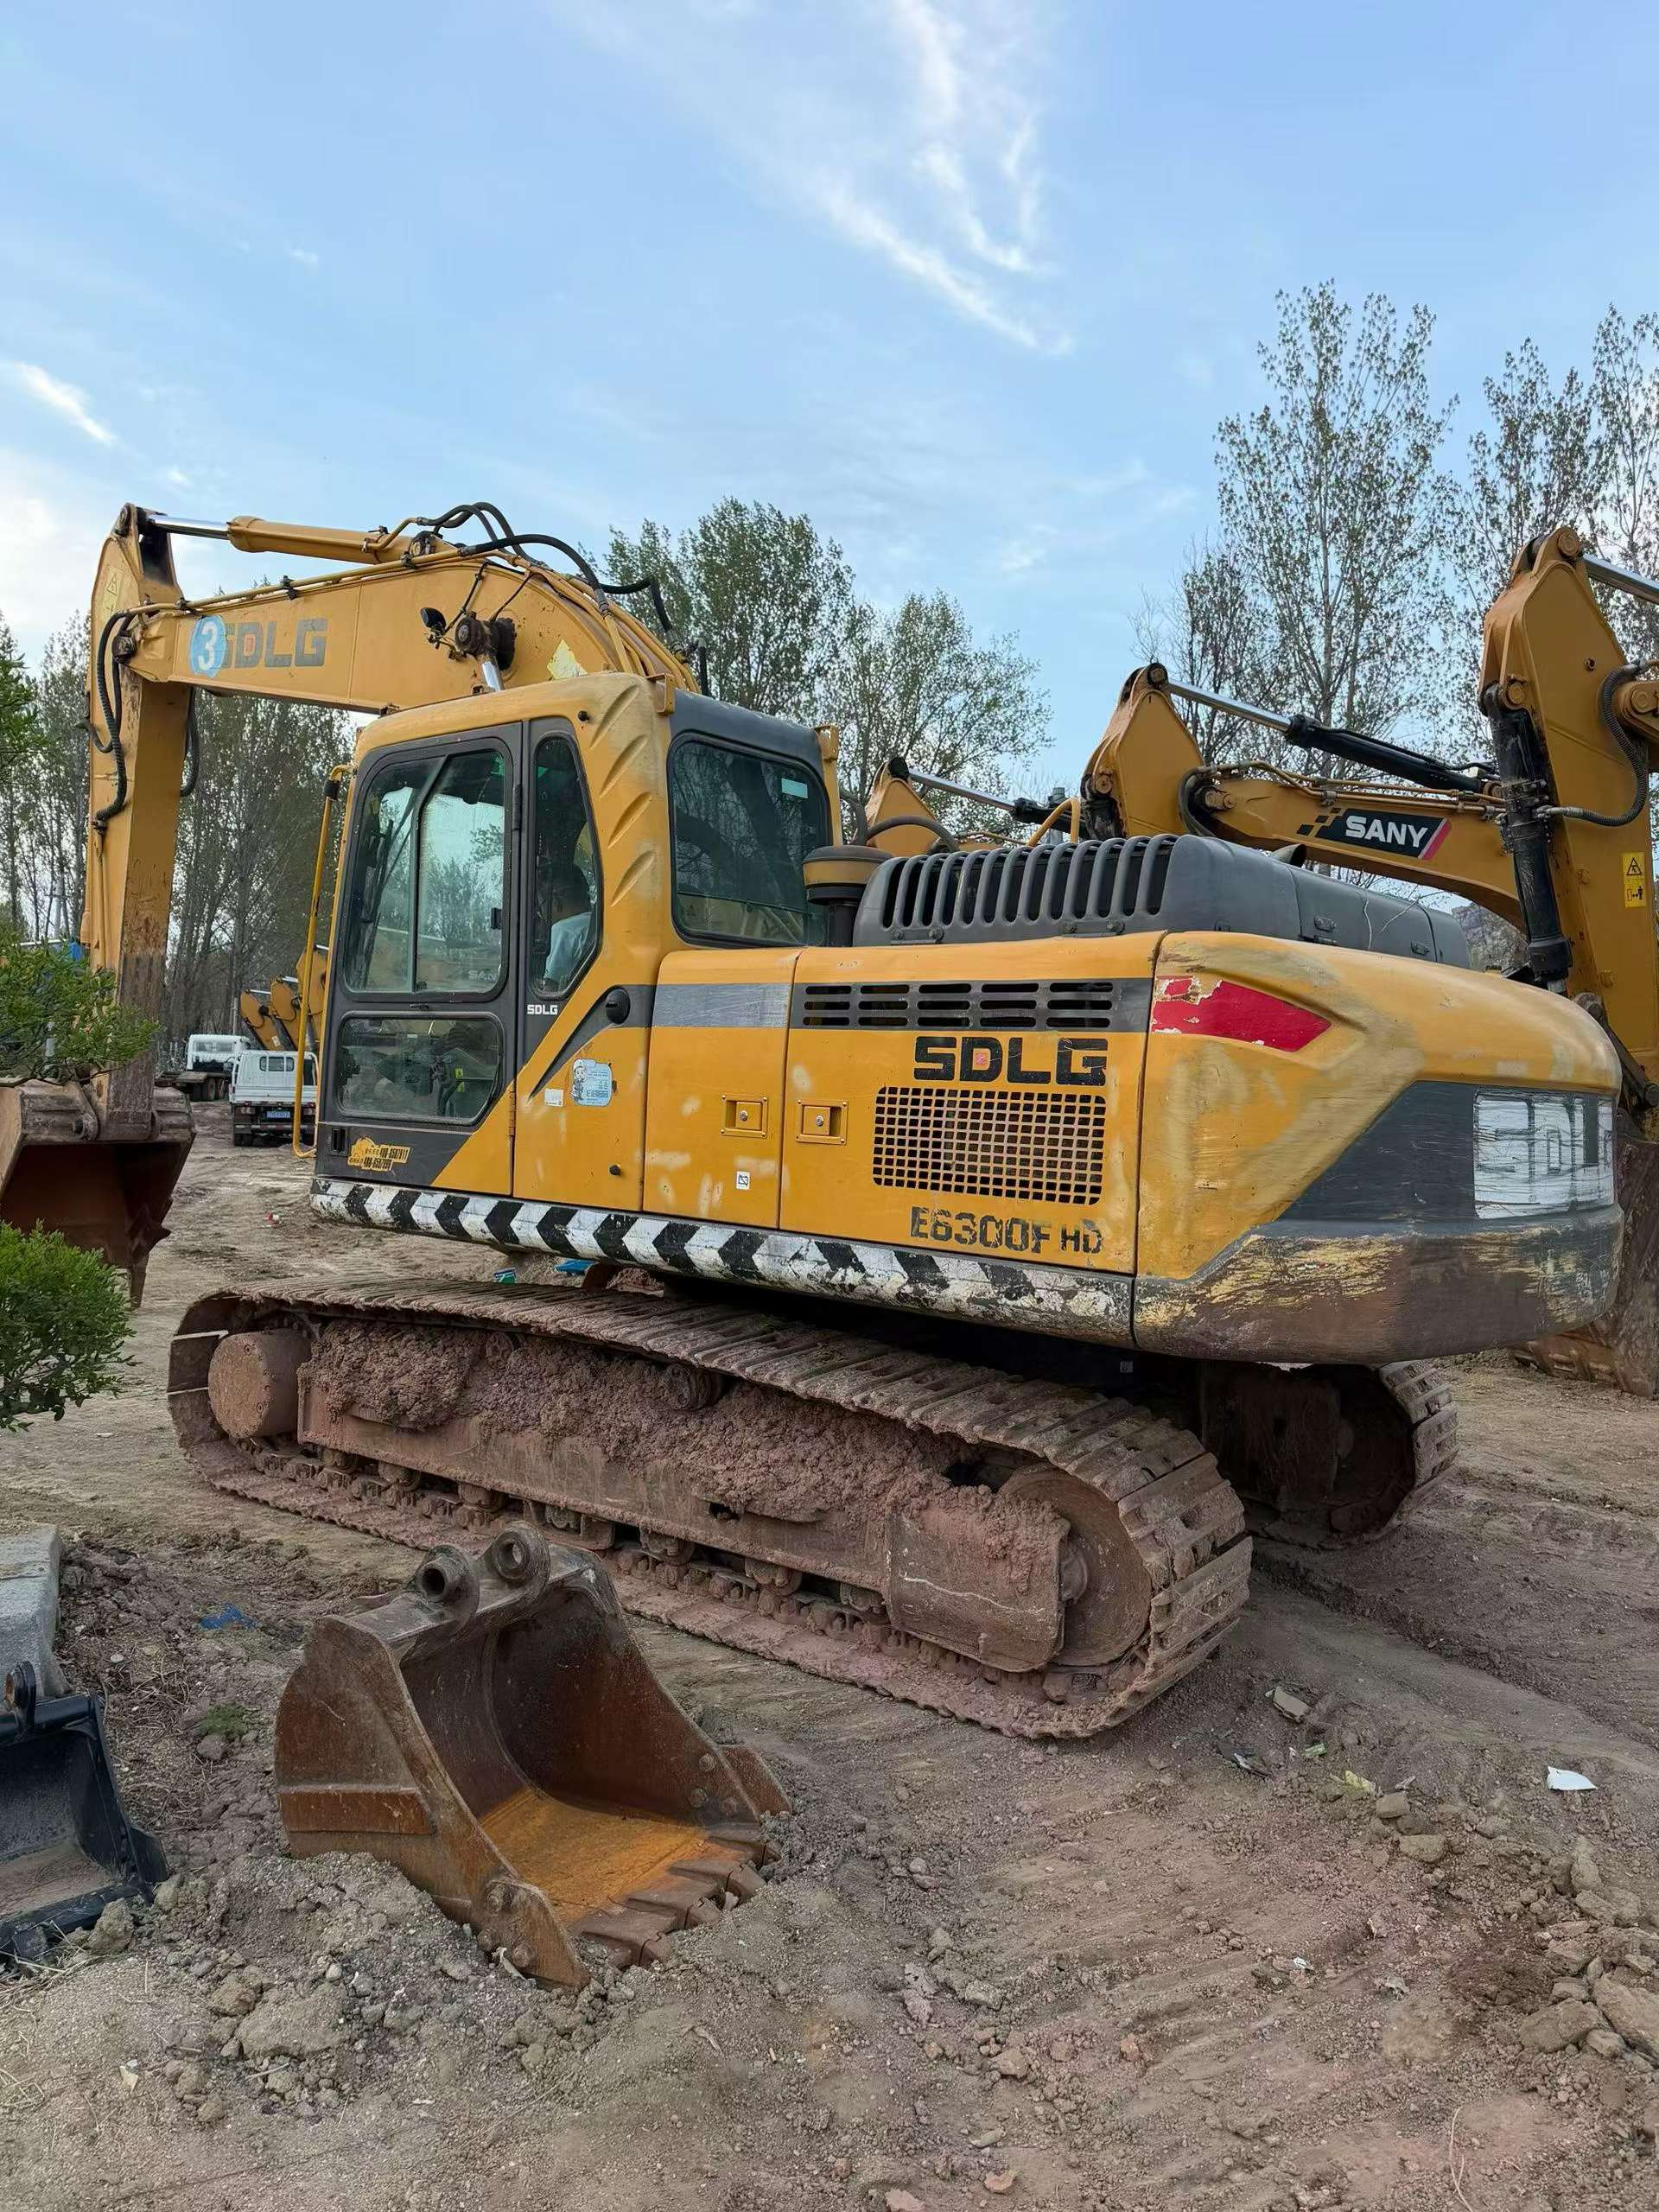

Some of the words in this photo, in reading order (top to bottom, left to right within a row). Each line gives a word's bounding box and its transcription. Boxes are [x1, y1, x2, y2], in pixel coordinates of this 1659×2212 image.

[198, 620, 218, 671] 3
[1345, 815, 1428, 848] SANY
[527, 1004, 558, 1015] SDLG
[913, 1036, 1109, 1086] SDLG
[910, 1206, 1052, 1254] E6300F
[1061, 1218, 1103, 1254] HD
